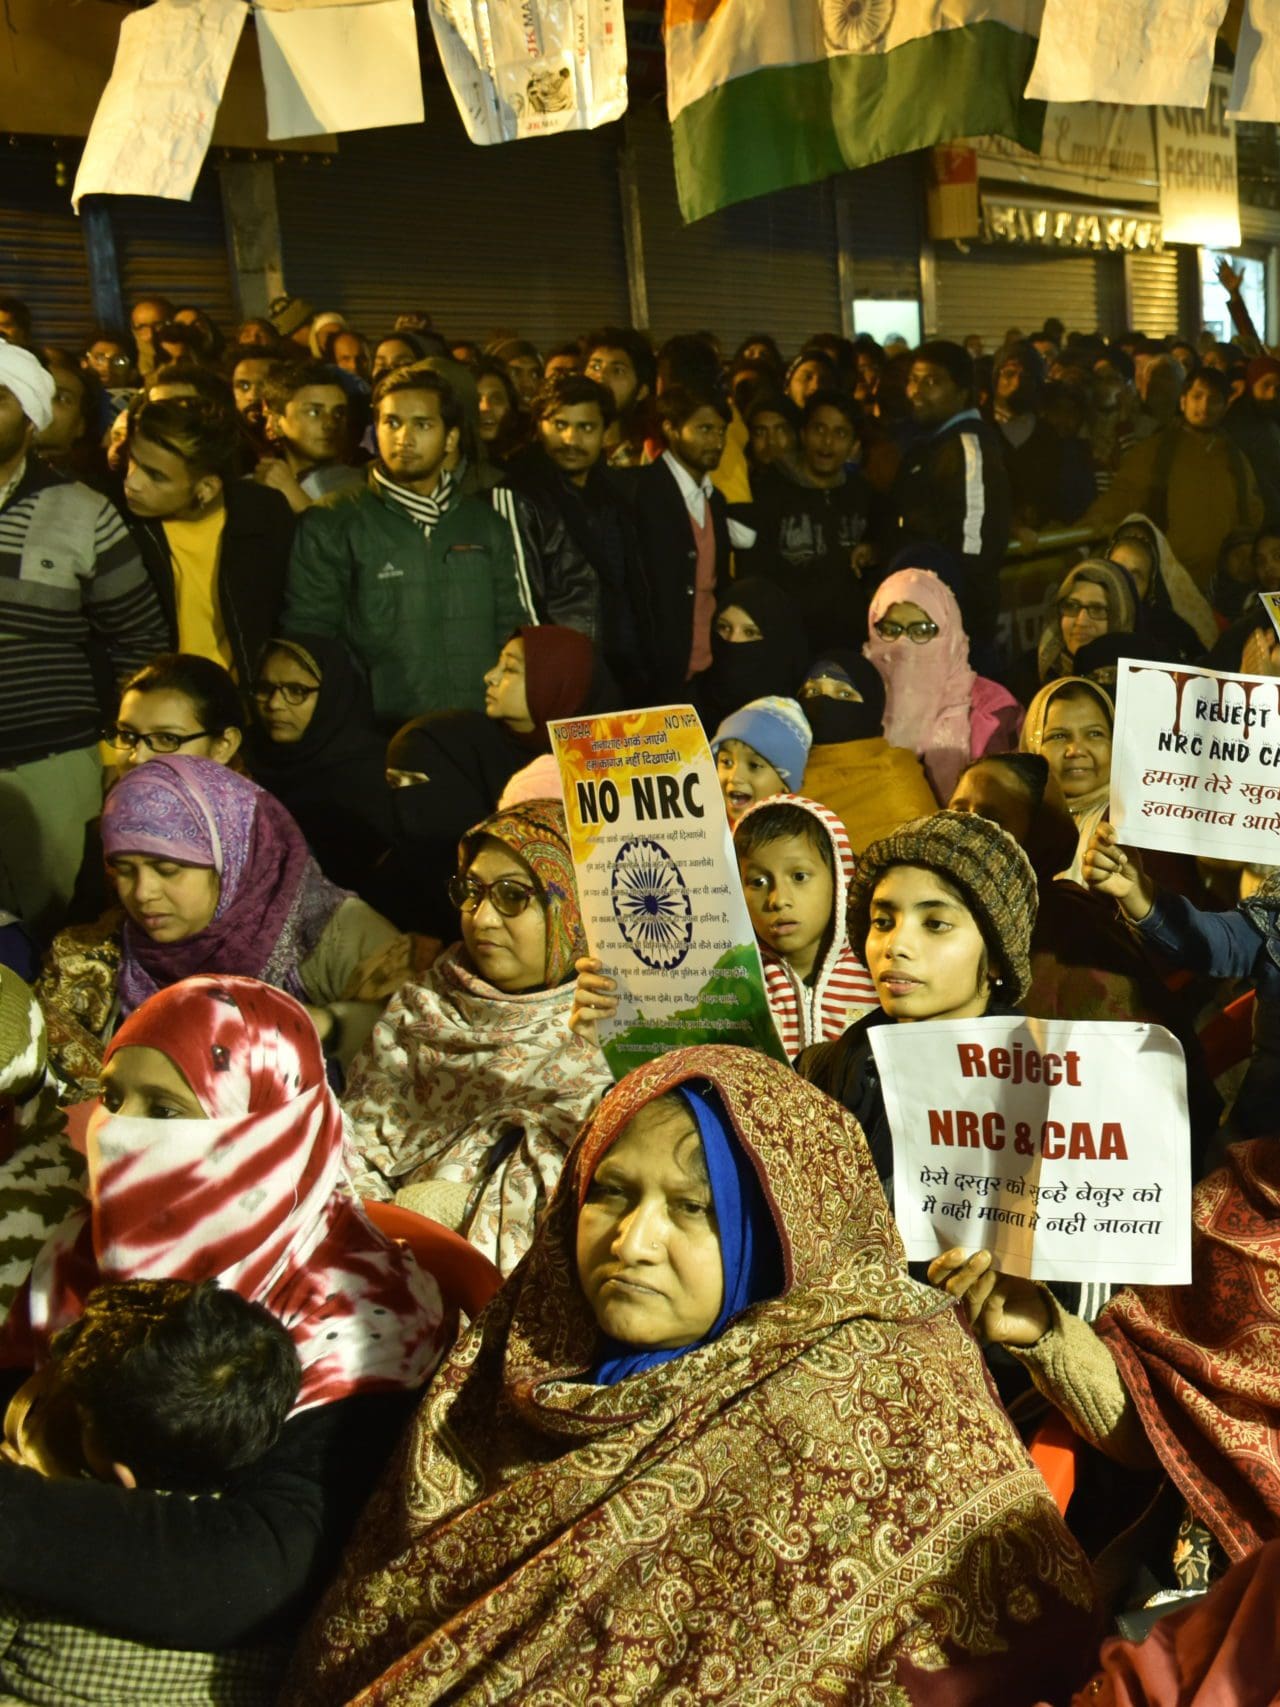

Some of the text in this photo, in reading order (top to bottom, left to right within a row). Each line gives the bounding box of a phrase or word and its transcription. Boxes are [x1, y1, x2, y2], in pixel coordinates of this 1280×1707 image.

[664, 715, 680, 730] NO
[1195, 698, 1271, 728] REJECT
[554, 726, 570, 740] NO
[1158, 730, 1203, 757] NRC
[1209, 737, 1250, 763] AND
[577, 772, 705, 824] NO NRC
[1203, 773, 1233, 794] तेरे
[1141, 800, 1237, 827] इनकलाब
[957, 1042, 1082, 1087] Reject
[928, 1109, 1128, 1161] NRC & CAA
[920, 1165, 949, 1187] ऐसे
[954, 1172, 1001, 1196] दस्तुर
[1006, 1176, 1026, 1197] को
[1132, 1182, 1163, 1203] को
[942, 1199, 972, 1221] नही
[978, 1206, 1025, 1228] मानता
[1046, 1212, 1085, 1234] नही
[1093, 1218, 1164, 1236] जानता
